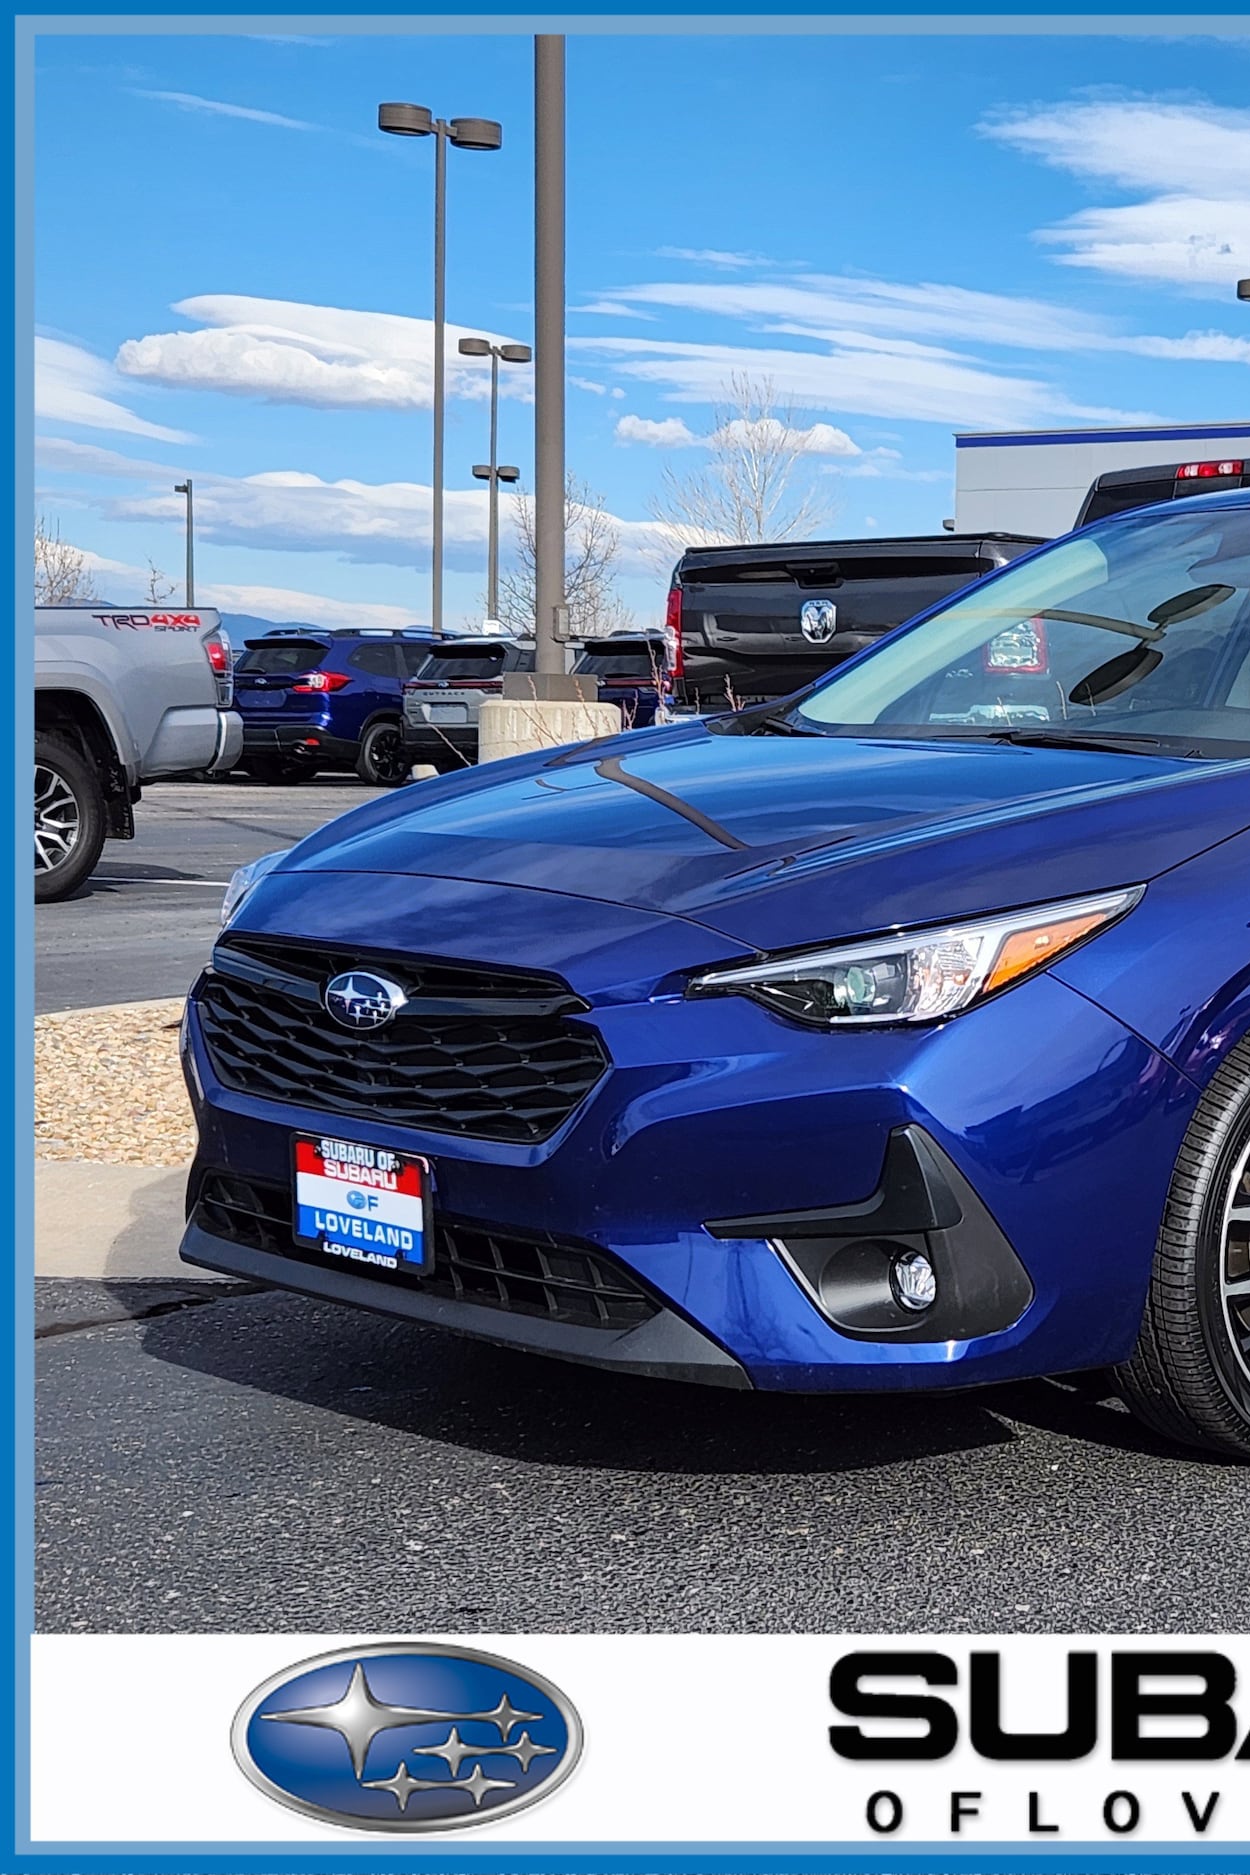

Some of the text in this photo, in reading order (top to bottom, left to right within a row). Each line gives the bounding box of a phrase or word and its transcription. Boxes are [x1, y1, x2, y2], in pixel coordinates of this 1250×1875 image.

[91, 614, 151, 631] TRD
[320, 1139, 396, 1171] SUBARU OF
[323, 1159, 398, 1190] SUBARU
[314, 1210, 413, 1250] LOVELAND
[323, 1241, 398, 1269] LOVELAND
